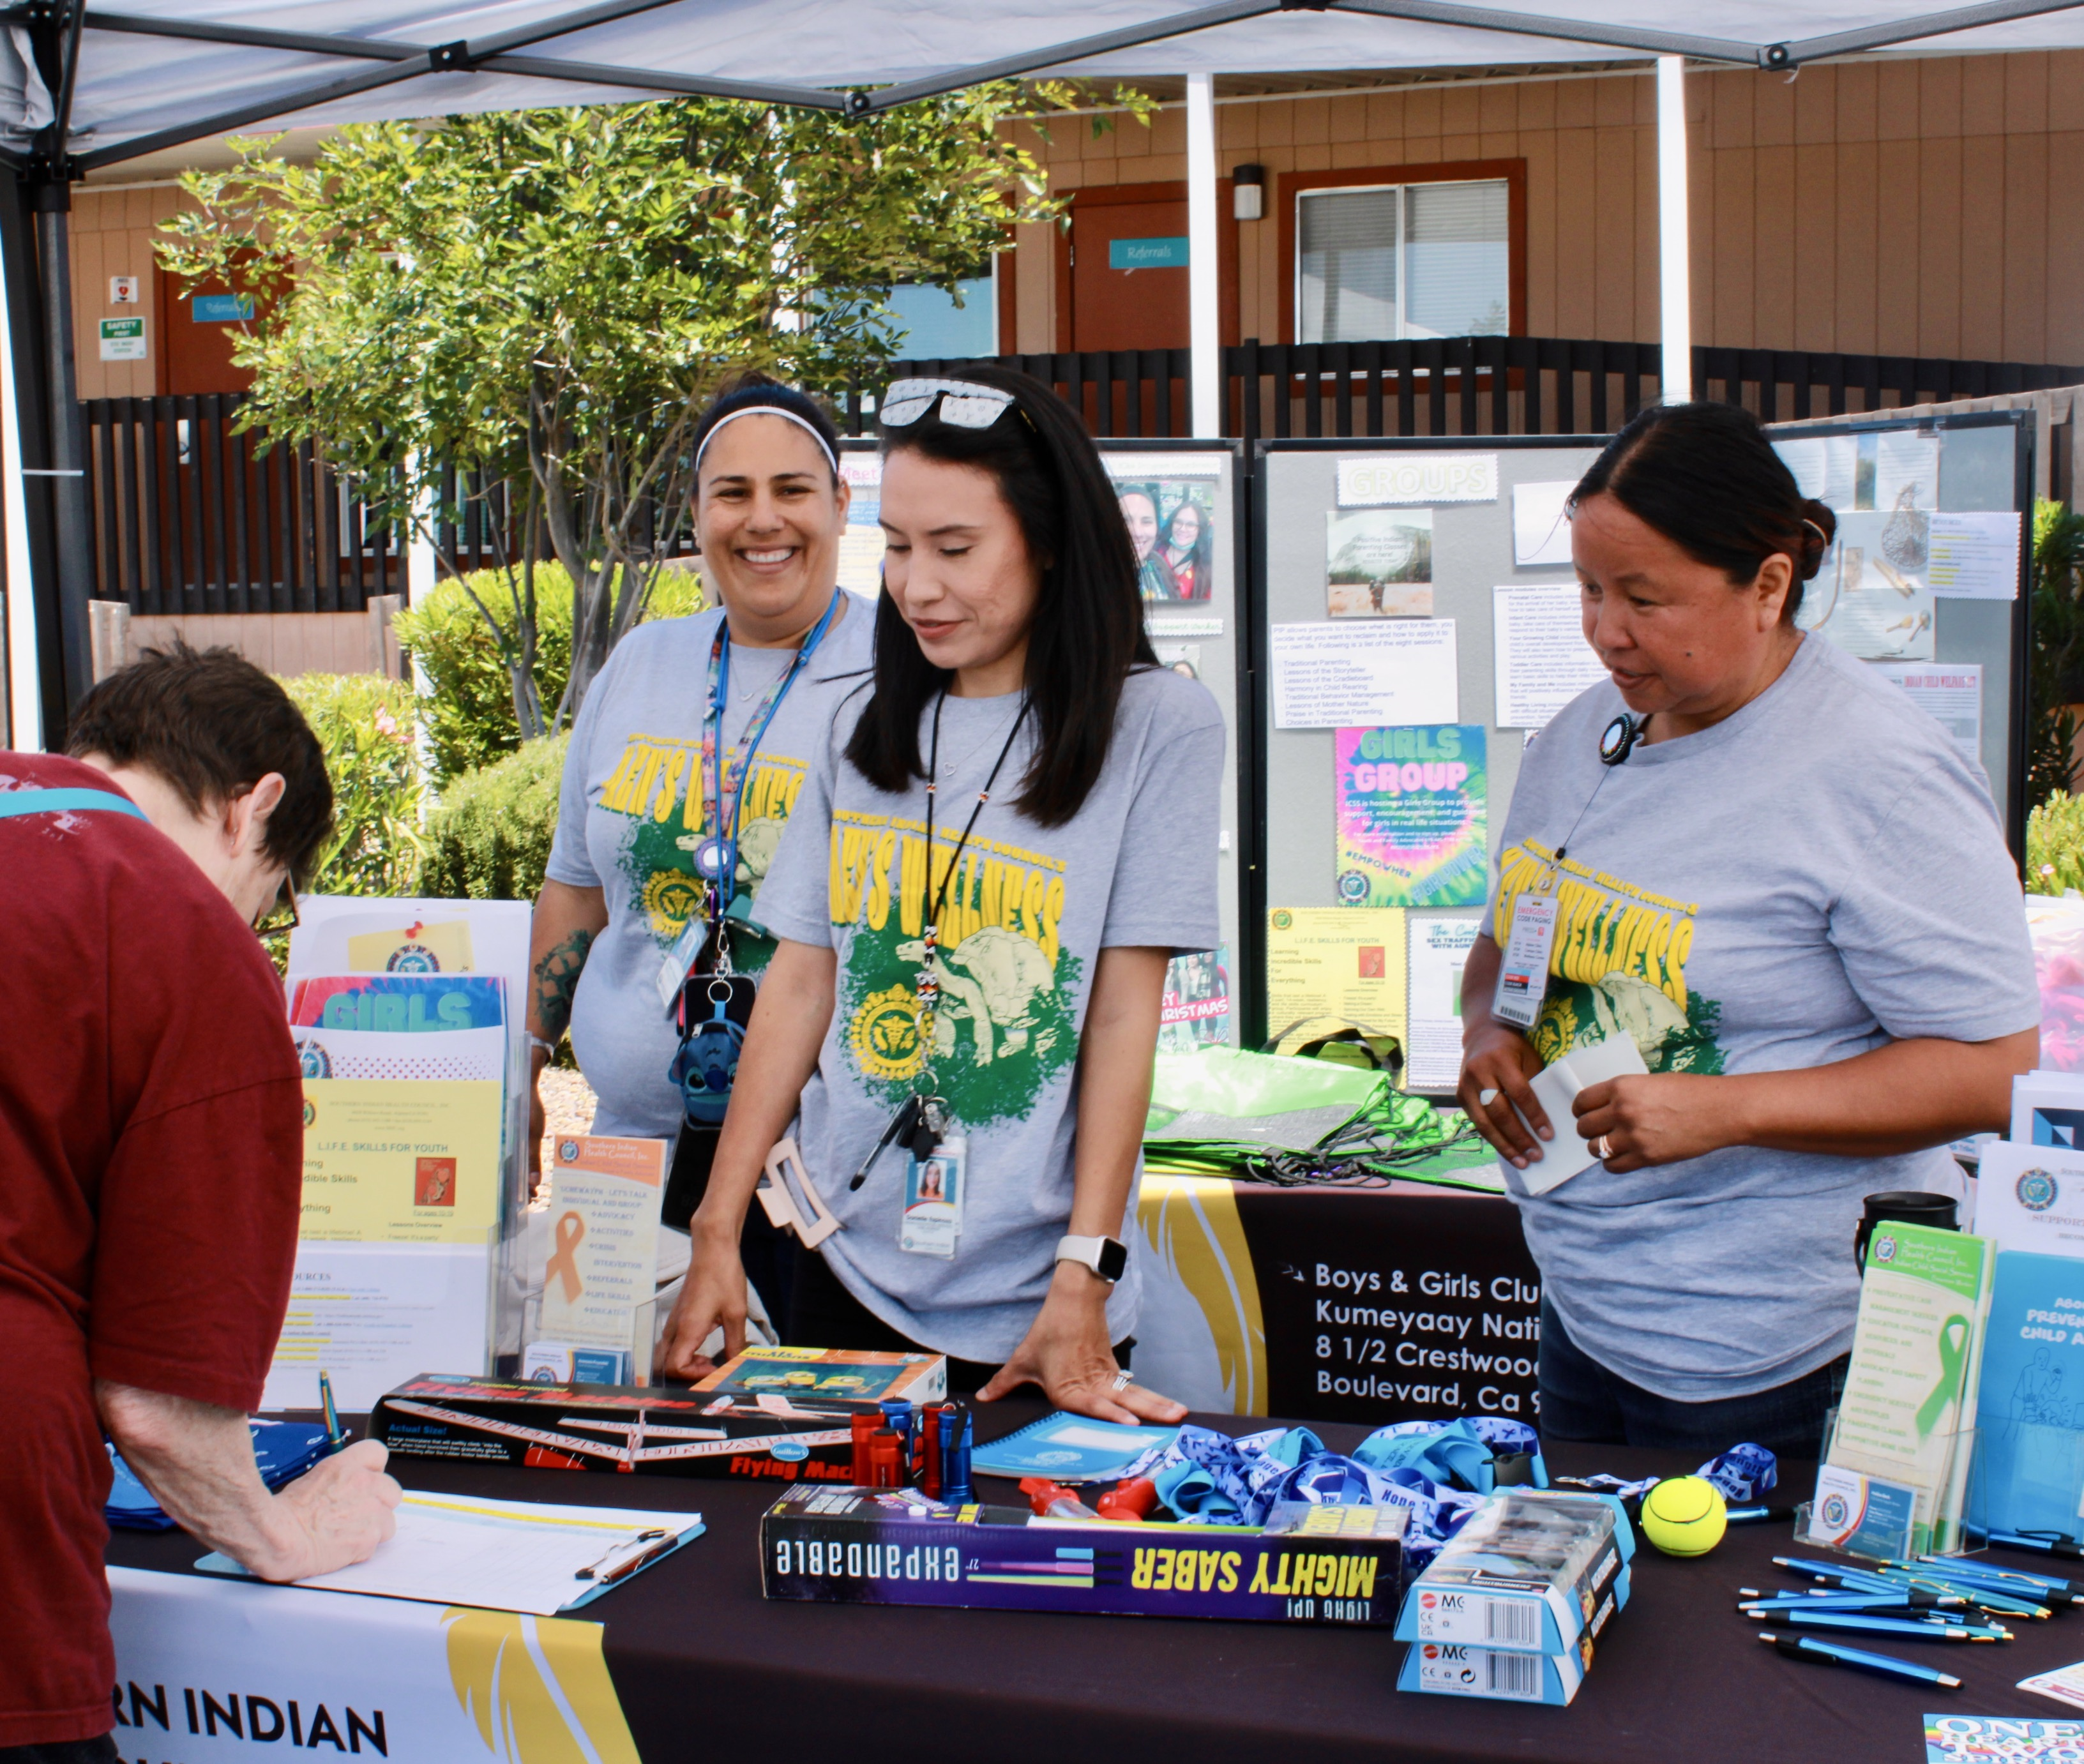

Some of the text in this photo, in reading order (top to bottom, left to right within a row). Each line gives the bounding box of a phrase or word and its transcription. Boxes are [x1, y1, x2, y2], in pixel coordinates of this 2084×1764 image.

[1126, 243, 1172, 260] Referrals
[105, 321, 137, 329] SAFETY
[1348, 465, 1487, 495] GROUPS
[1361, 728, 1461, 759] GIRLS
[1354, 762, 1468, 792] GROUP
[833, 810, 889, 826] OUTHERN
[1412, 845, 1484, 903] #GIRLPOWER
[1595, 871, 1642, 898] HEALTH
[1517, 907, 1553, 917] EMERGENCY
[1550, 877, 1694, 1014] WELLNESS
[322, 991, 472, 1032] GIRLS
[353, 1143, 388, 1151] SKILLS
[414, 1143, 448, 1152] YOUTH
[331, 1174, 358, 1183] Skills
[597, 1212, 635, 1221] ADVOCACY
[596, 1227, 634, 1236] ACTIVITIES
[592, 1275, 633, 1285] REFERRALS
[1315, 1262, 1380, 1295] Boys
[1390, 1269, 1408, 1293] &
[1419, 1270, 1481, 1300] Girls
[1315, 1299, 1540, 1341] Kumeyaay Nati
[2020, 1326, 2067, 1343] CHILD
[1315, 1336, 1332, 1359] 8
[1342, 1336, 1386, 1366] 1/2
[404, 1382, 528, 1399] Flying
[532, 1390, 696, 1409] Machine
[520, 1383, 569, 1393] powered
[1317, 1369, 1467, 1409] Boulevard,
[1477, 1385, 1520, 1413] Ca
[388, 1424, 447, 1435] Actual Size!
[730, 1456, 798, 1480] Flying
[1131, 1548, 1378, 1598] MIGHTY SABER
[183, 1687, 388, 1758] INDIAN
[1935, 1717, 2084, 1739] ONE
[1940, 1742, 2084, 1761] TWO
